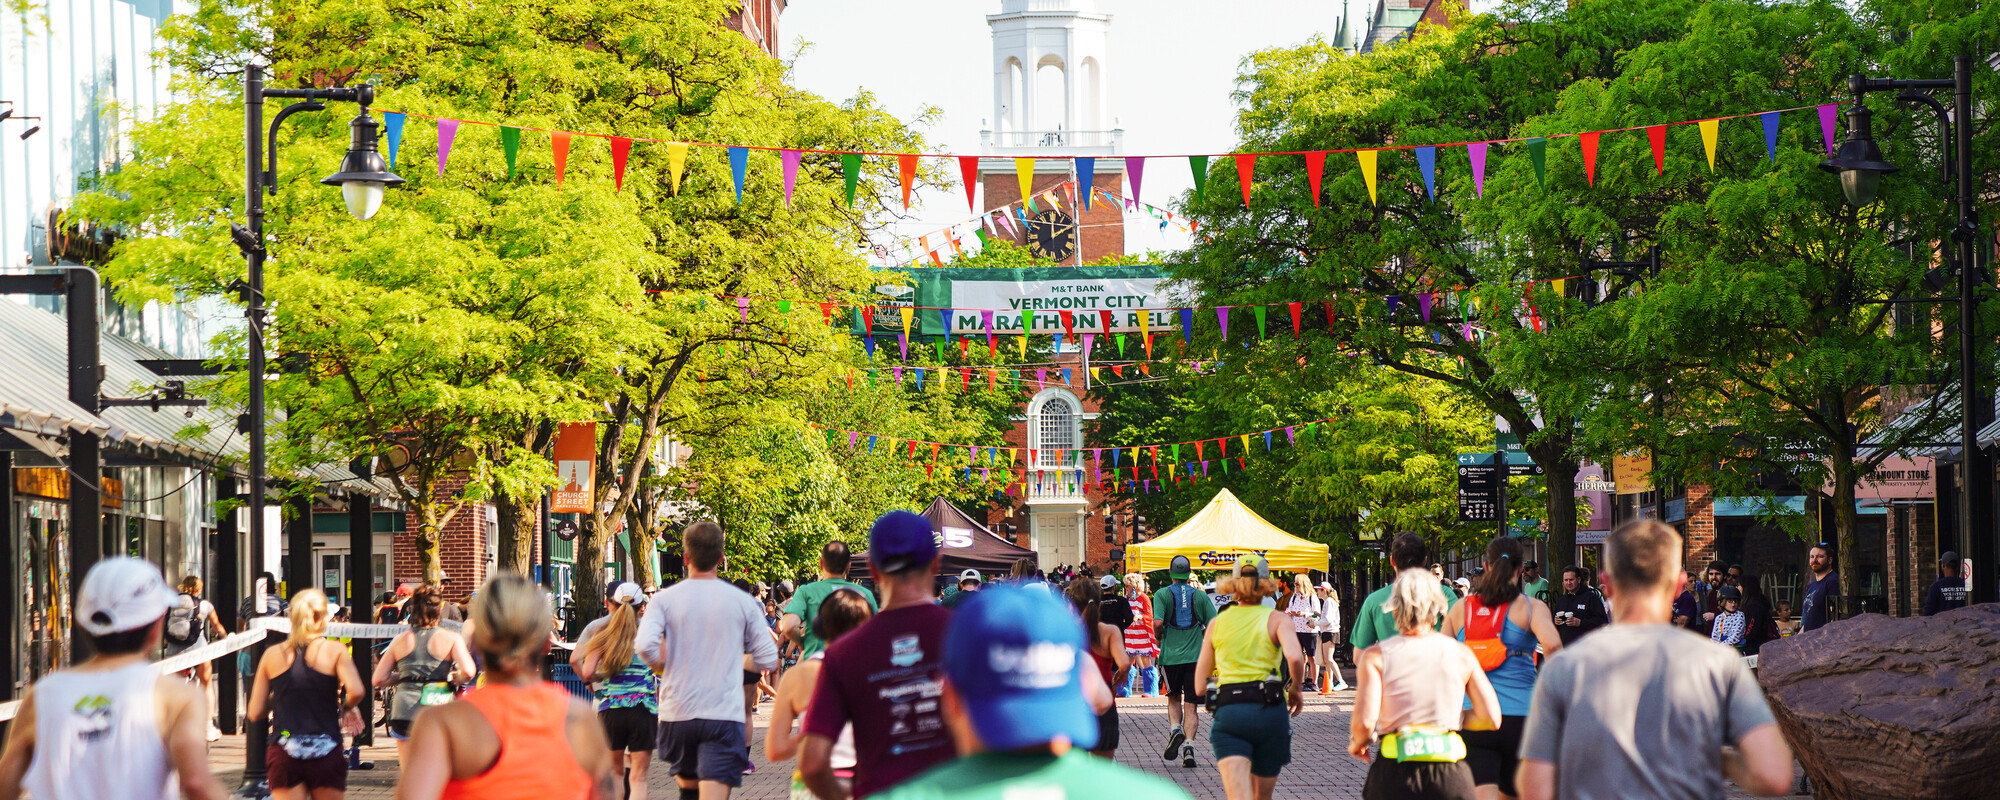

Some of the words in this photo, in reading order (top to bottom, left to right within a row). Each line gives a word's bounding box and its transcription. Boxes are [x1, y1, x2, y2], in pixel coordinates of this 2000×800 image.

[1051, 285, 1073, 293] M&T
[1076, 284, 1104, 293] BANK
[1008, 296, 1099, 310] VERMONT
[1105, 295, 1147, 308] CITY
[1127, 312, 1171, 328] REL
[1907, 470, 1930, 480] STORE
[1199, 550, 1269, 566] 95TRIX
